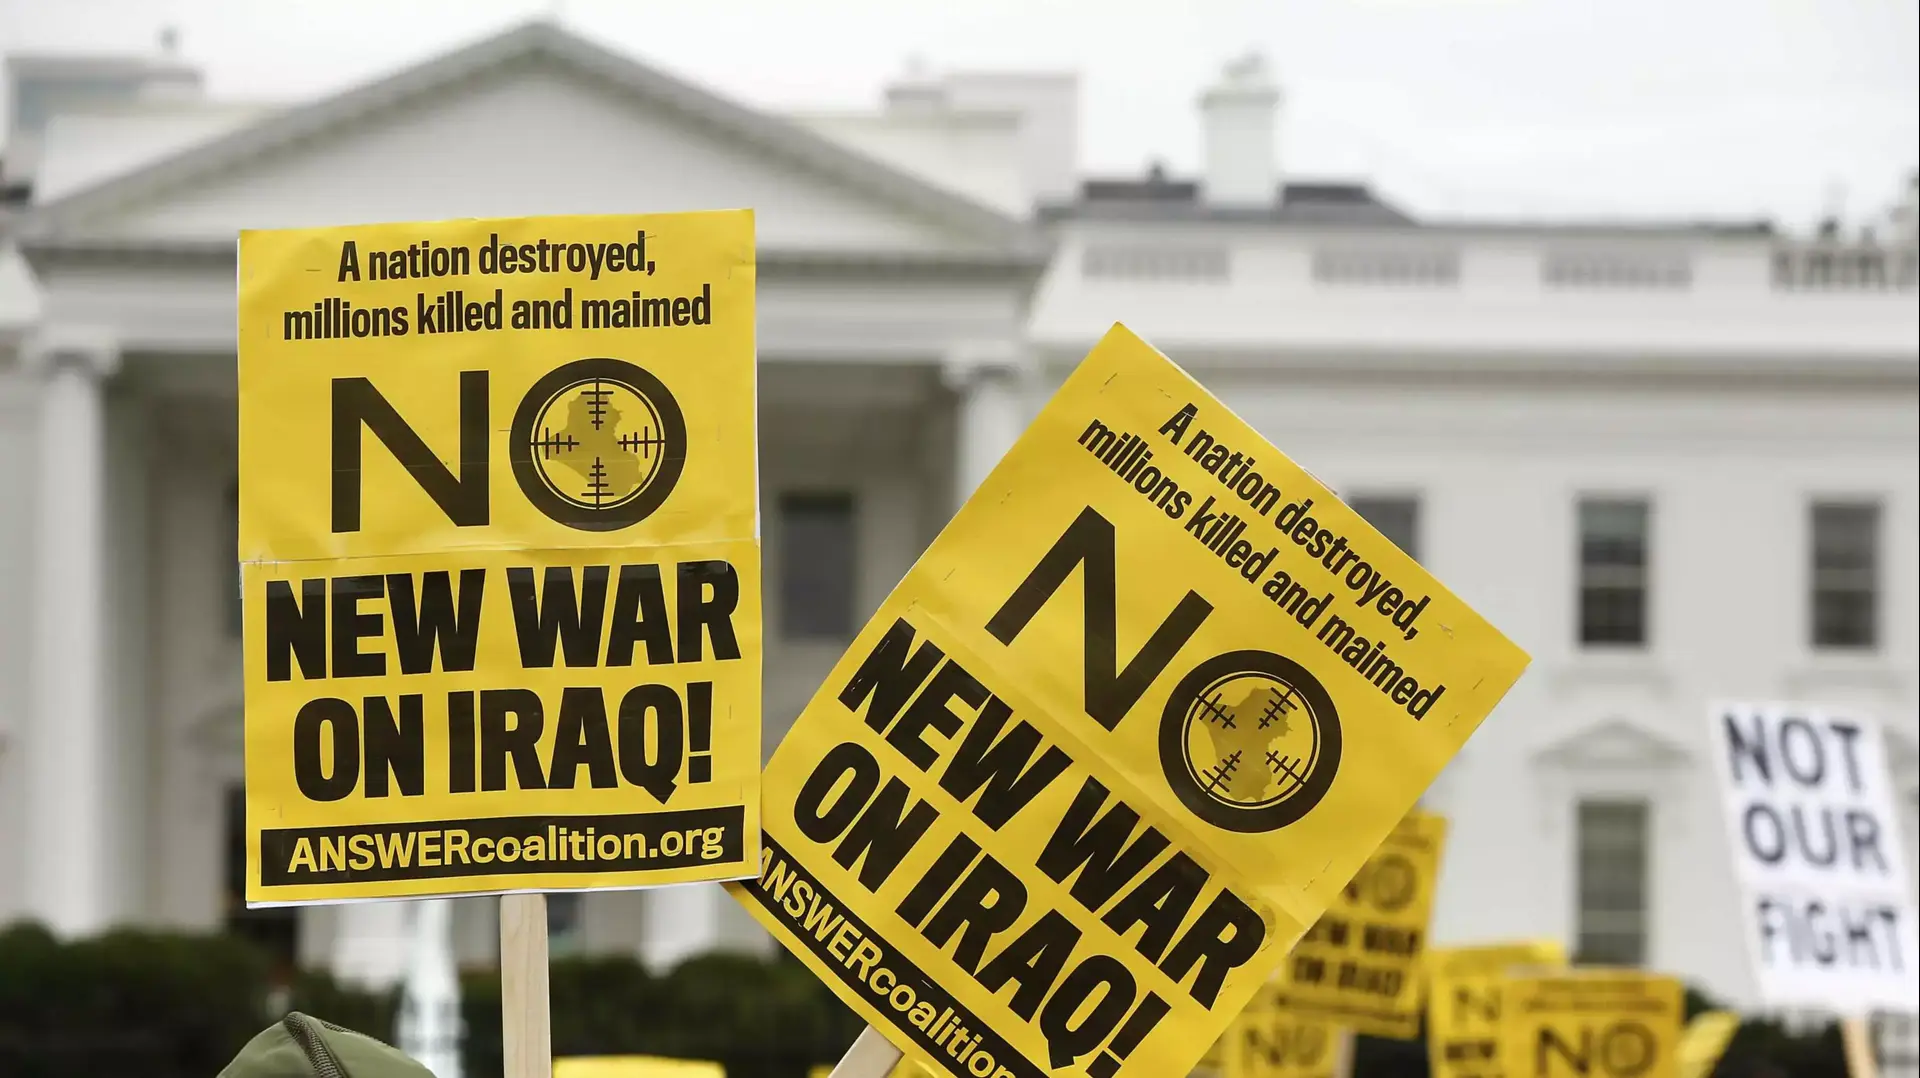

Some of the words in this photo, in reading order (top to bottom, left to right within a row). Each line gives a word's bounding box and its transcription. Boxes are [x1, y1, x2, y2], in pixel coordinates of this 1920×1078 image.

[284, 297, 408, 340] millions
[417, 289, 503, 334] killed
[511, 288, 573, 329] and
[582, 284, 711, 329] maimed
[337, 241, 360, 282] A
[369, 241, 469, 280] nation
[479, 230, 656, 280] destroyed,
[331, 358, 687, 533] NO
[1078, 418, 1193, 520] millions
[1185, 496, 1279, 585] killed
[1262, 570, 1334, 630] and
[1316, 614, 1445, 722] maimed
[1158, 402, 1199, 443] A
[1184, 431, 1281, 516] nation
[1274, 498, 1431, 642] destroyed,
[266, 569, 486, 682] NEW
[505, 559, 741, 669] WAR
[984, 505, 1342, 834] NO
[294, 693, 424, 802] ON
[448, 681, 713, 805] IRAQ!
[1722, 713, 1861, 793] NOT
[287, 824, 725, 874] ANSWERcoalition.org
[837, 617, 1074, 832] NEW
[1034, 775, 1265, 1011] WAR
[1744, 802, 1889, 874] OUR
[793, 741, 940, 894] ON
[894, 831, 1172, 1078] IRAQ!
[1534, 1019, 1658, 1078] NO
